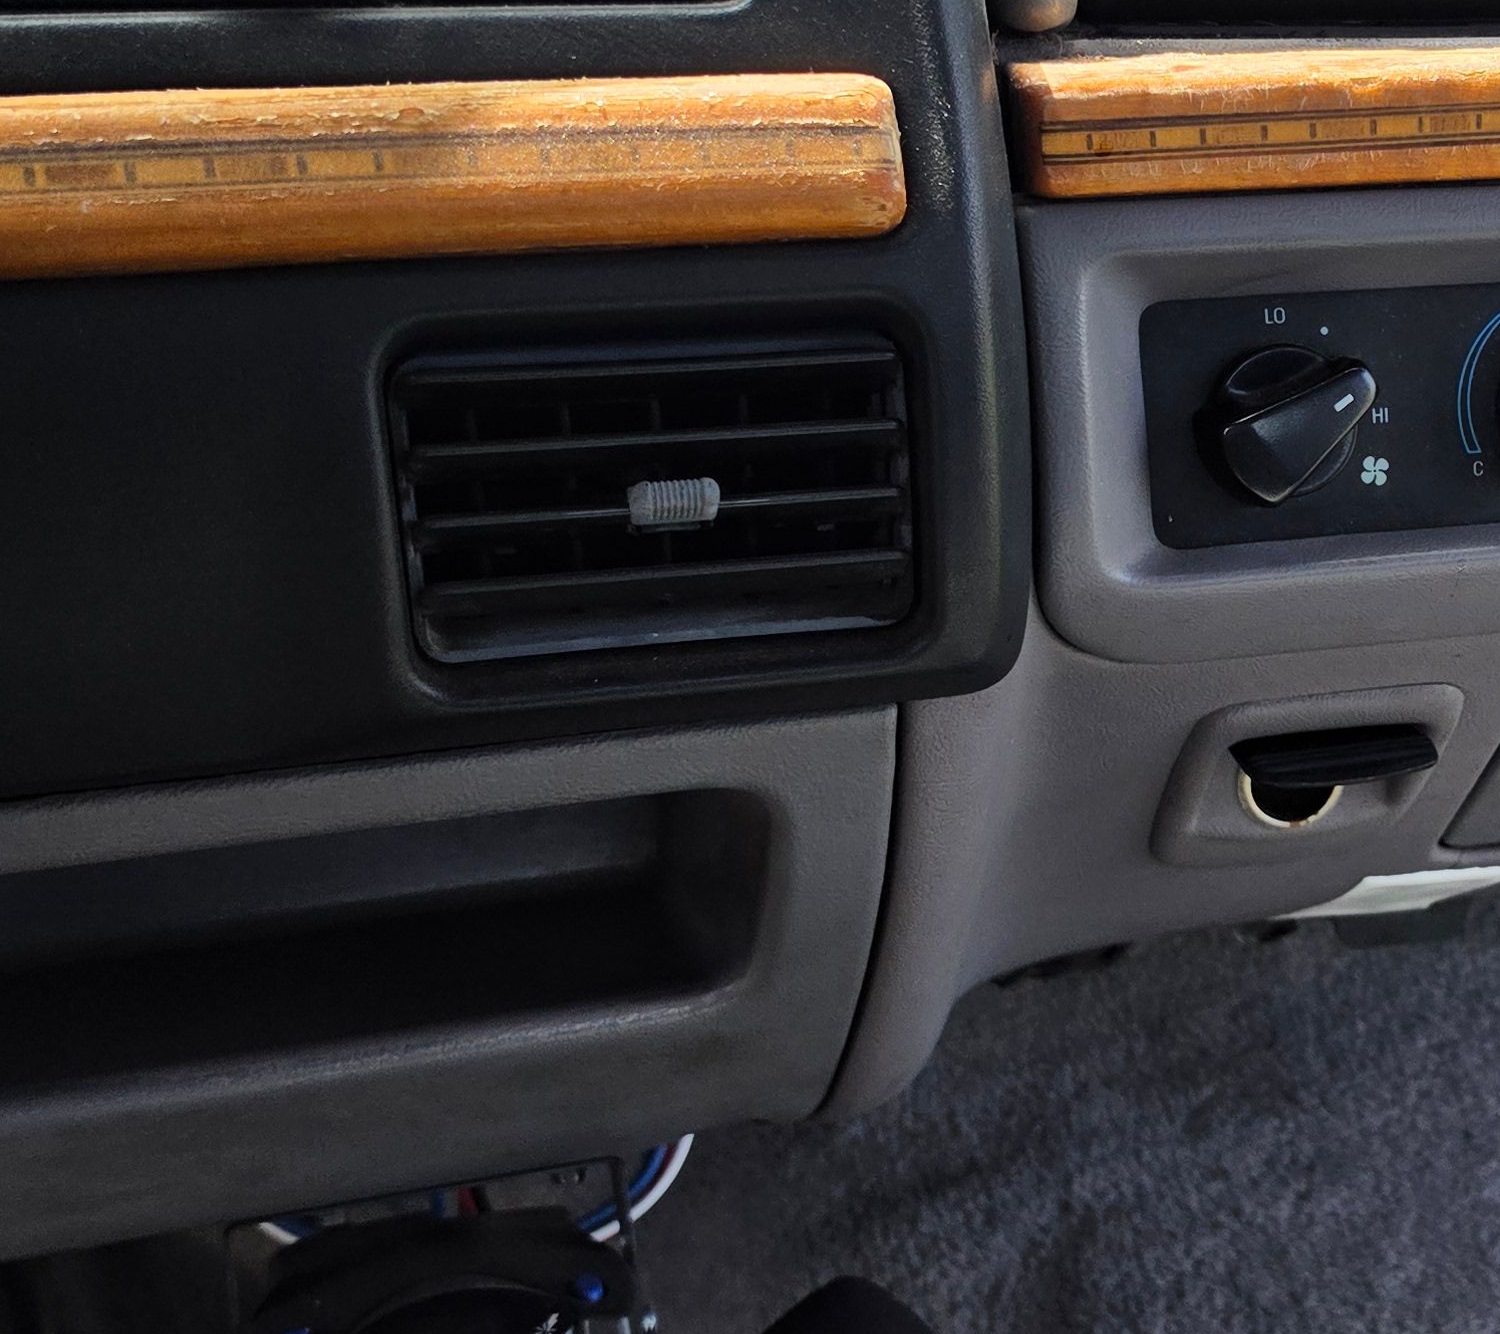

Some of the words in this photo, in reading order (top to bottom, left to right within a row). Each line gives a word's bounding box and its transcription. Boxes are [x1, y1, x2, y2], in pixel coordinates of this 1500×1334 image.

[1264, 307, 1286, 325] LO
[1371, 407, 1389, 424] HI
[1472, 460, 1484, 476] C
